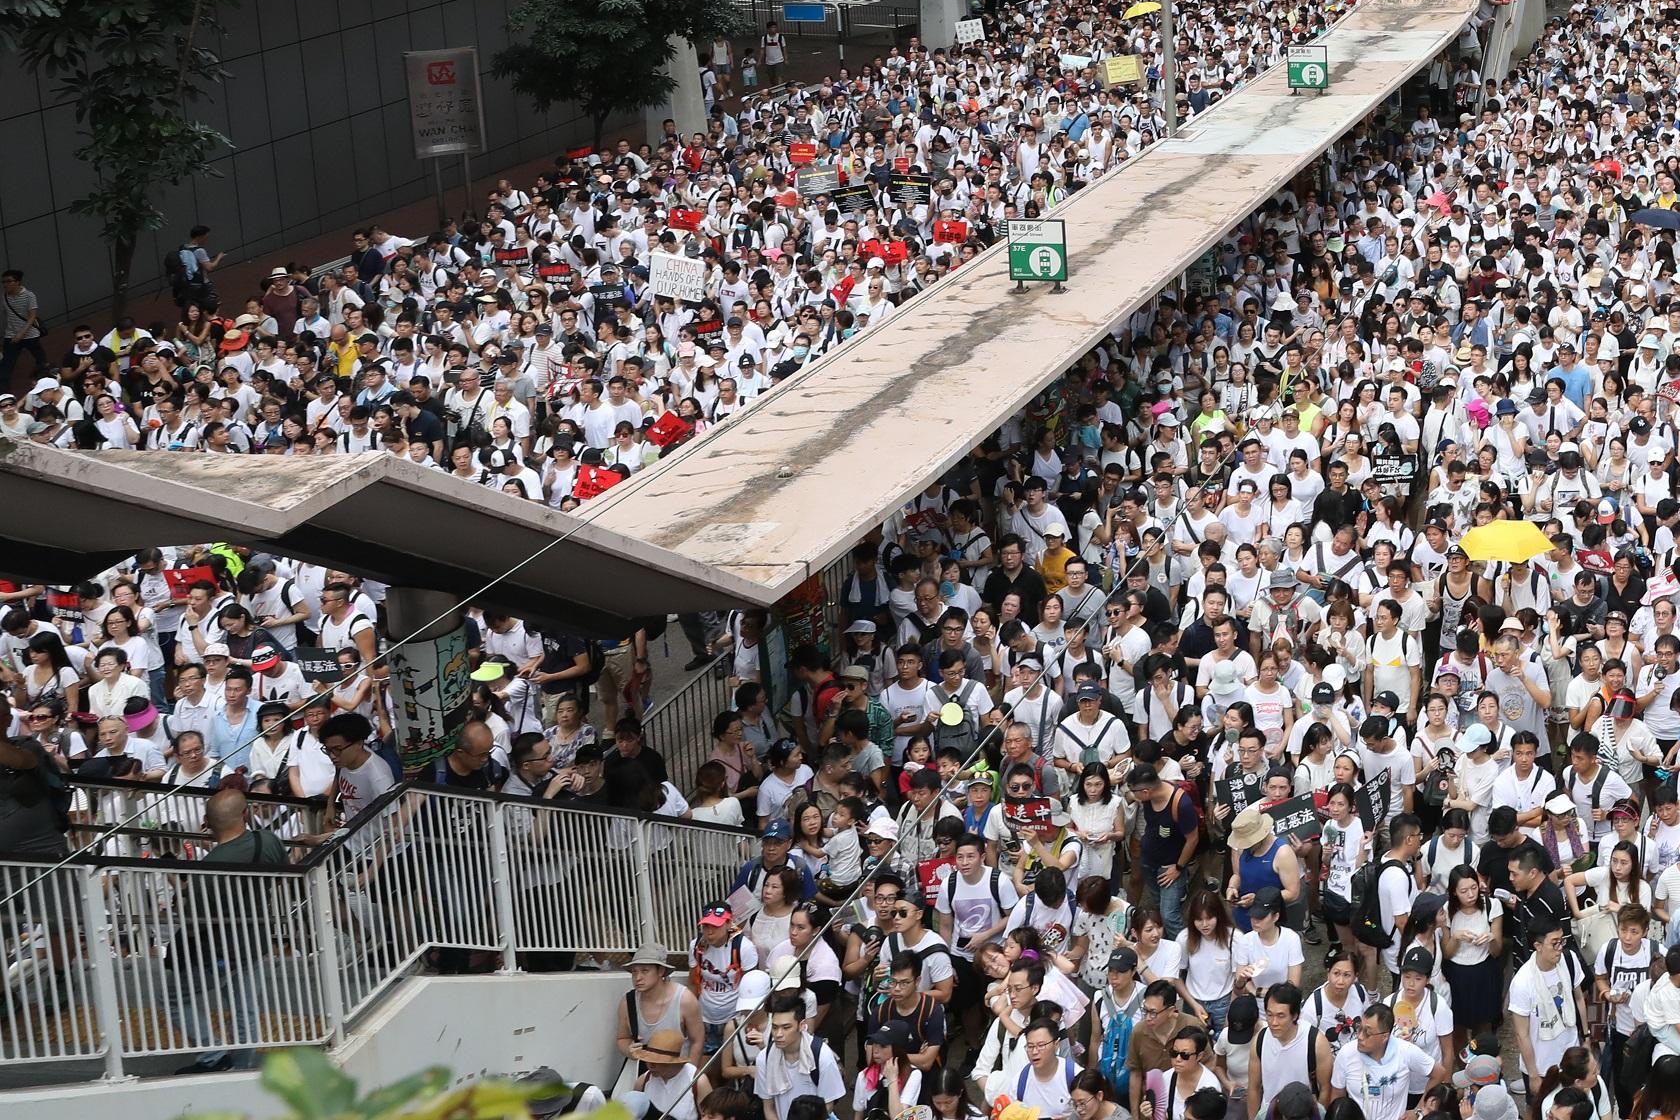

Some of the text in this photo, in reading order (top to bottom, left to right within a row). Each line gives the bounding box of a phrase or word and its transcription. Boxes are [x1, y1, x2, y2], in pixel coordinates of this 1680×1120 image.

[418, 128, 446, 137] WAN
[667, 258, 698, 273] CHINA
[656, 269, 704, 286] HANDS OFF
[657, 281, 680, 296] OUR
[340, 776, 357, 794] NIKE
